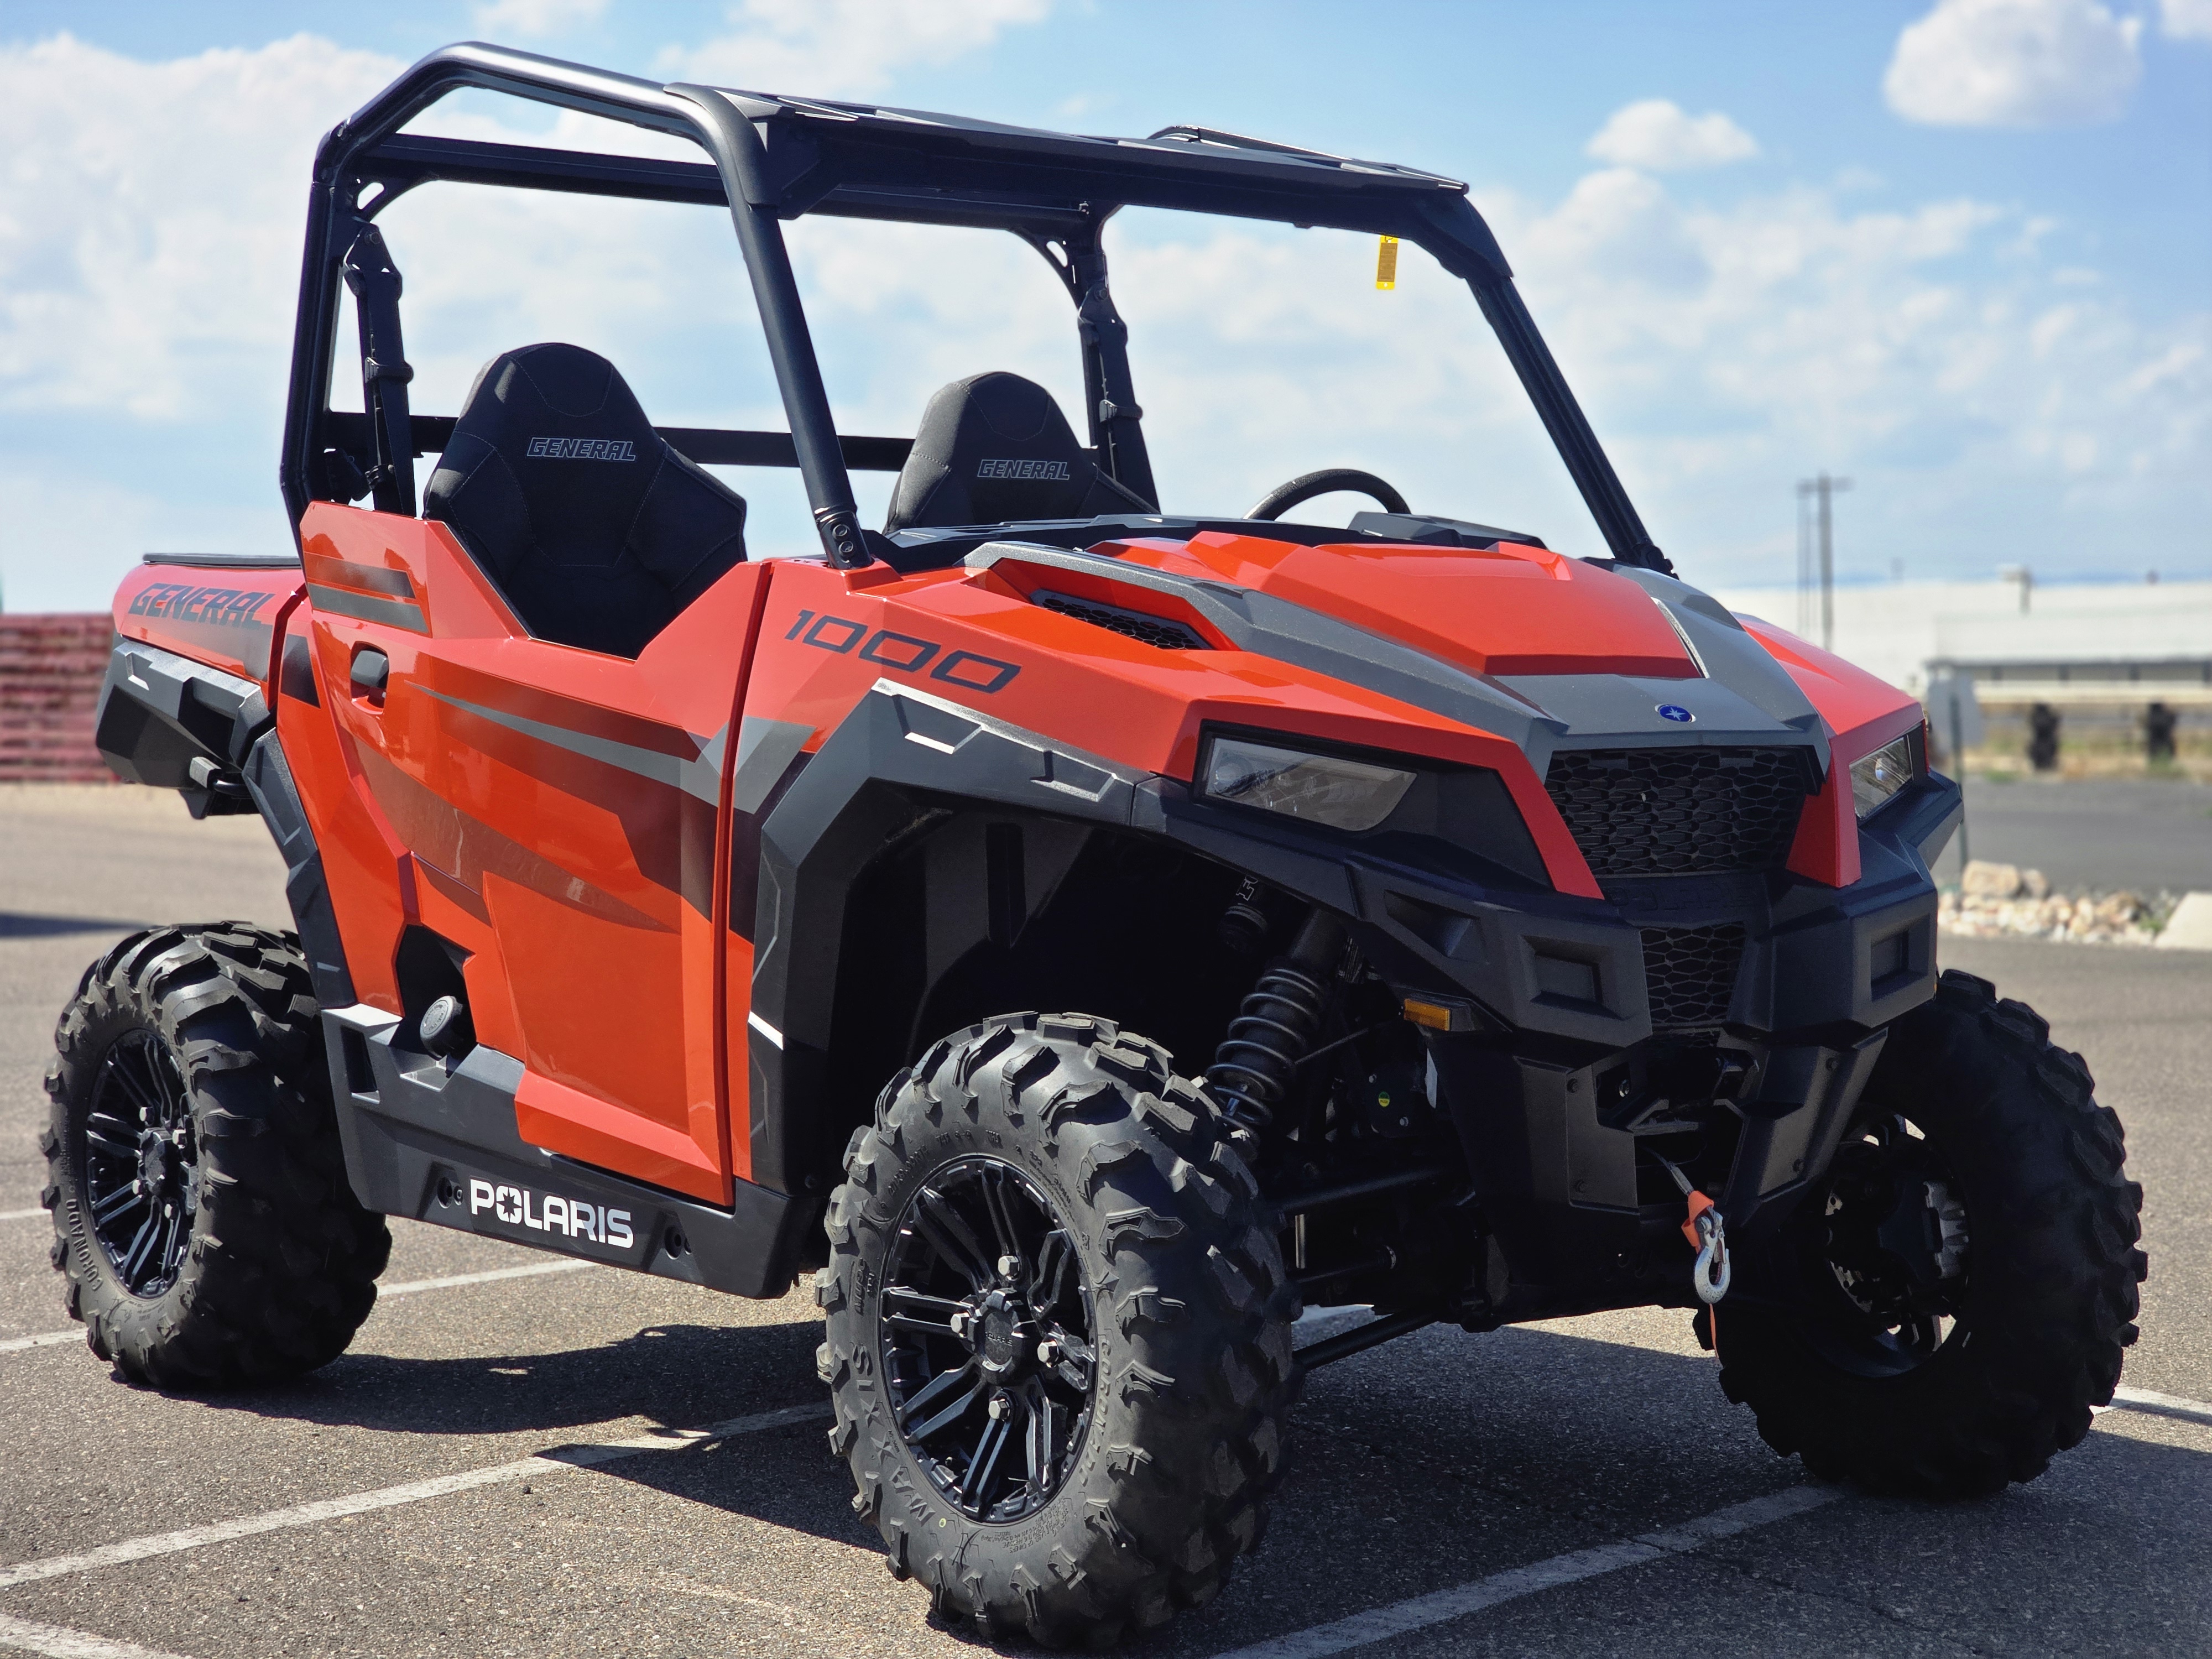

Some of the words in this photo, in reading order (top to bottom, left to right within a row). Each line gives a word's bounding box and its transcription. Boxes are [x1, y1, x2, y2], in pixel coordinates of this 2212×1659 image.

[526, 436, 637, 461] GENERAL
[977, 458, 1070, 481] GENERAL
[128, 583, 275, 628] GENERAL
[785, 609, 1023, 695] 1000
[66, 1198, 103, 1291] CORONADO
[469, 1178, 634, 1249] POLARIS
[853, 1343, 936, 1524] MAXXIS
[1079, 1339, 1112, 1486] CORONADO
